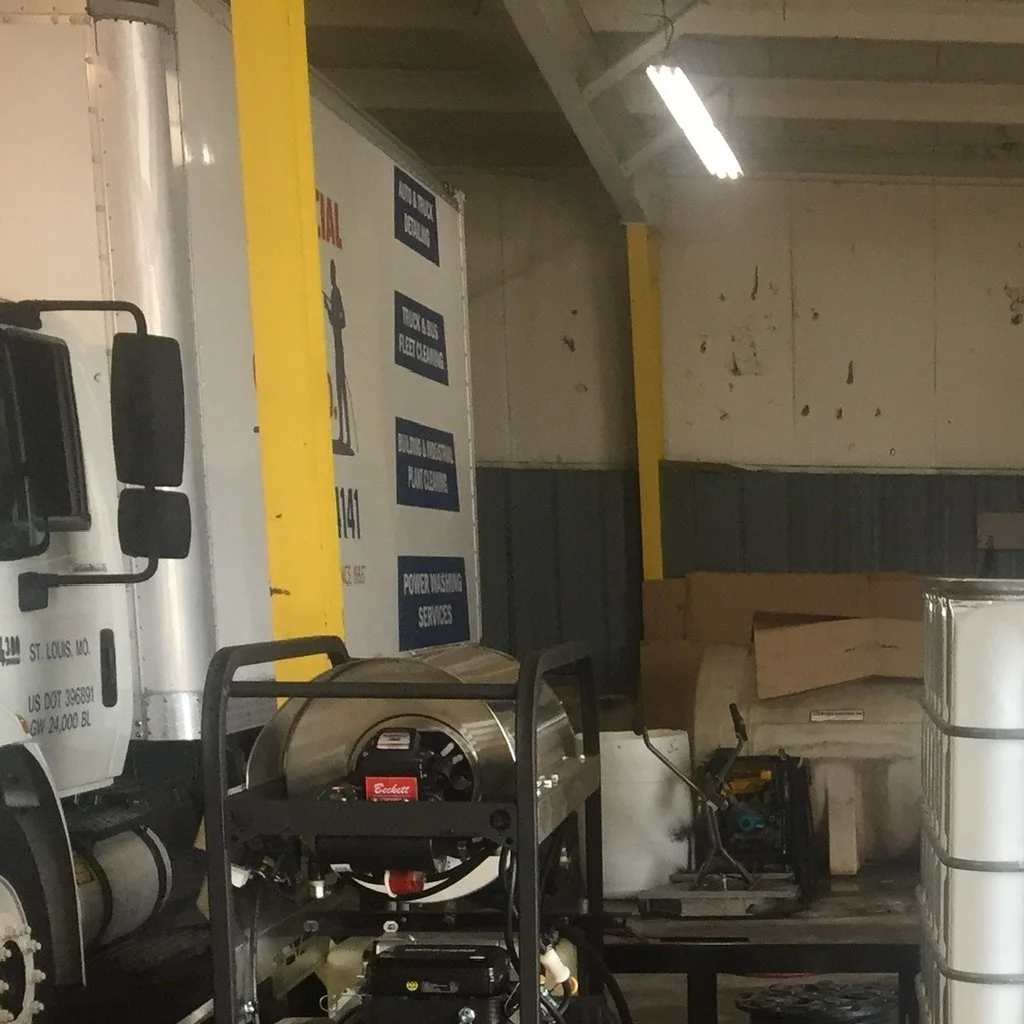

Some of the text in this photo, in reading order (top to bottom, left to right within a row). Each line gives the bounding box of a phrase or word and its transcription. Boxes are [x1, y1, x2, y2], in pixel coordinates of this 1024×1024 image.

[315, 187, 343, 250] IAL
[398, 332, 444, 370] FLEET CLEANING
[403, 571, 463, 596] POWER WASHING
[418, 604, 453, 629] SERVICES
[29, 643, 43, 662] ST.
[75, 637, 91, 657] MO.
[28, 693, 41, 713] US
[43, 690, 62, 711] DOT
[48, 711, 79, 734] 24,000
[374, 783, 410, 794] Beckett
